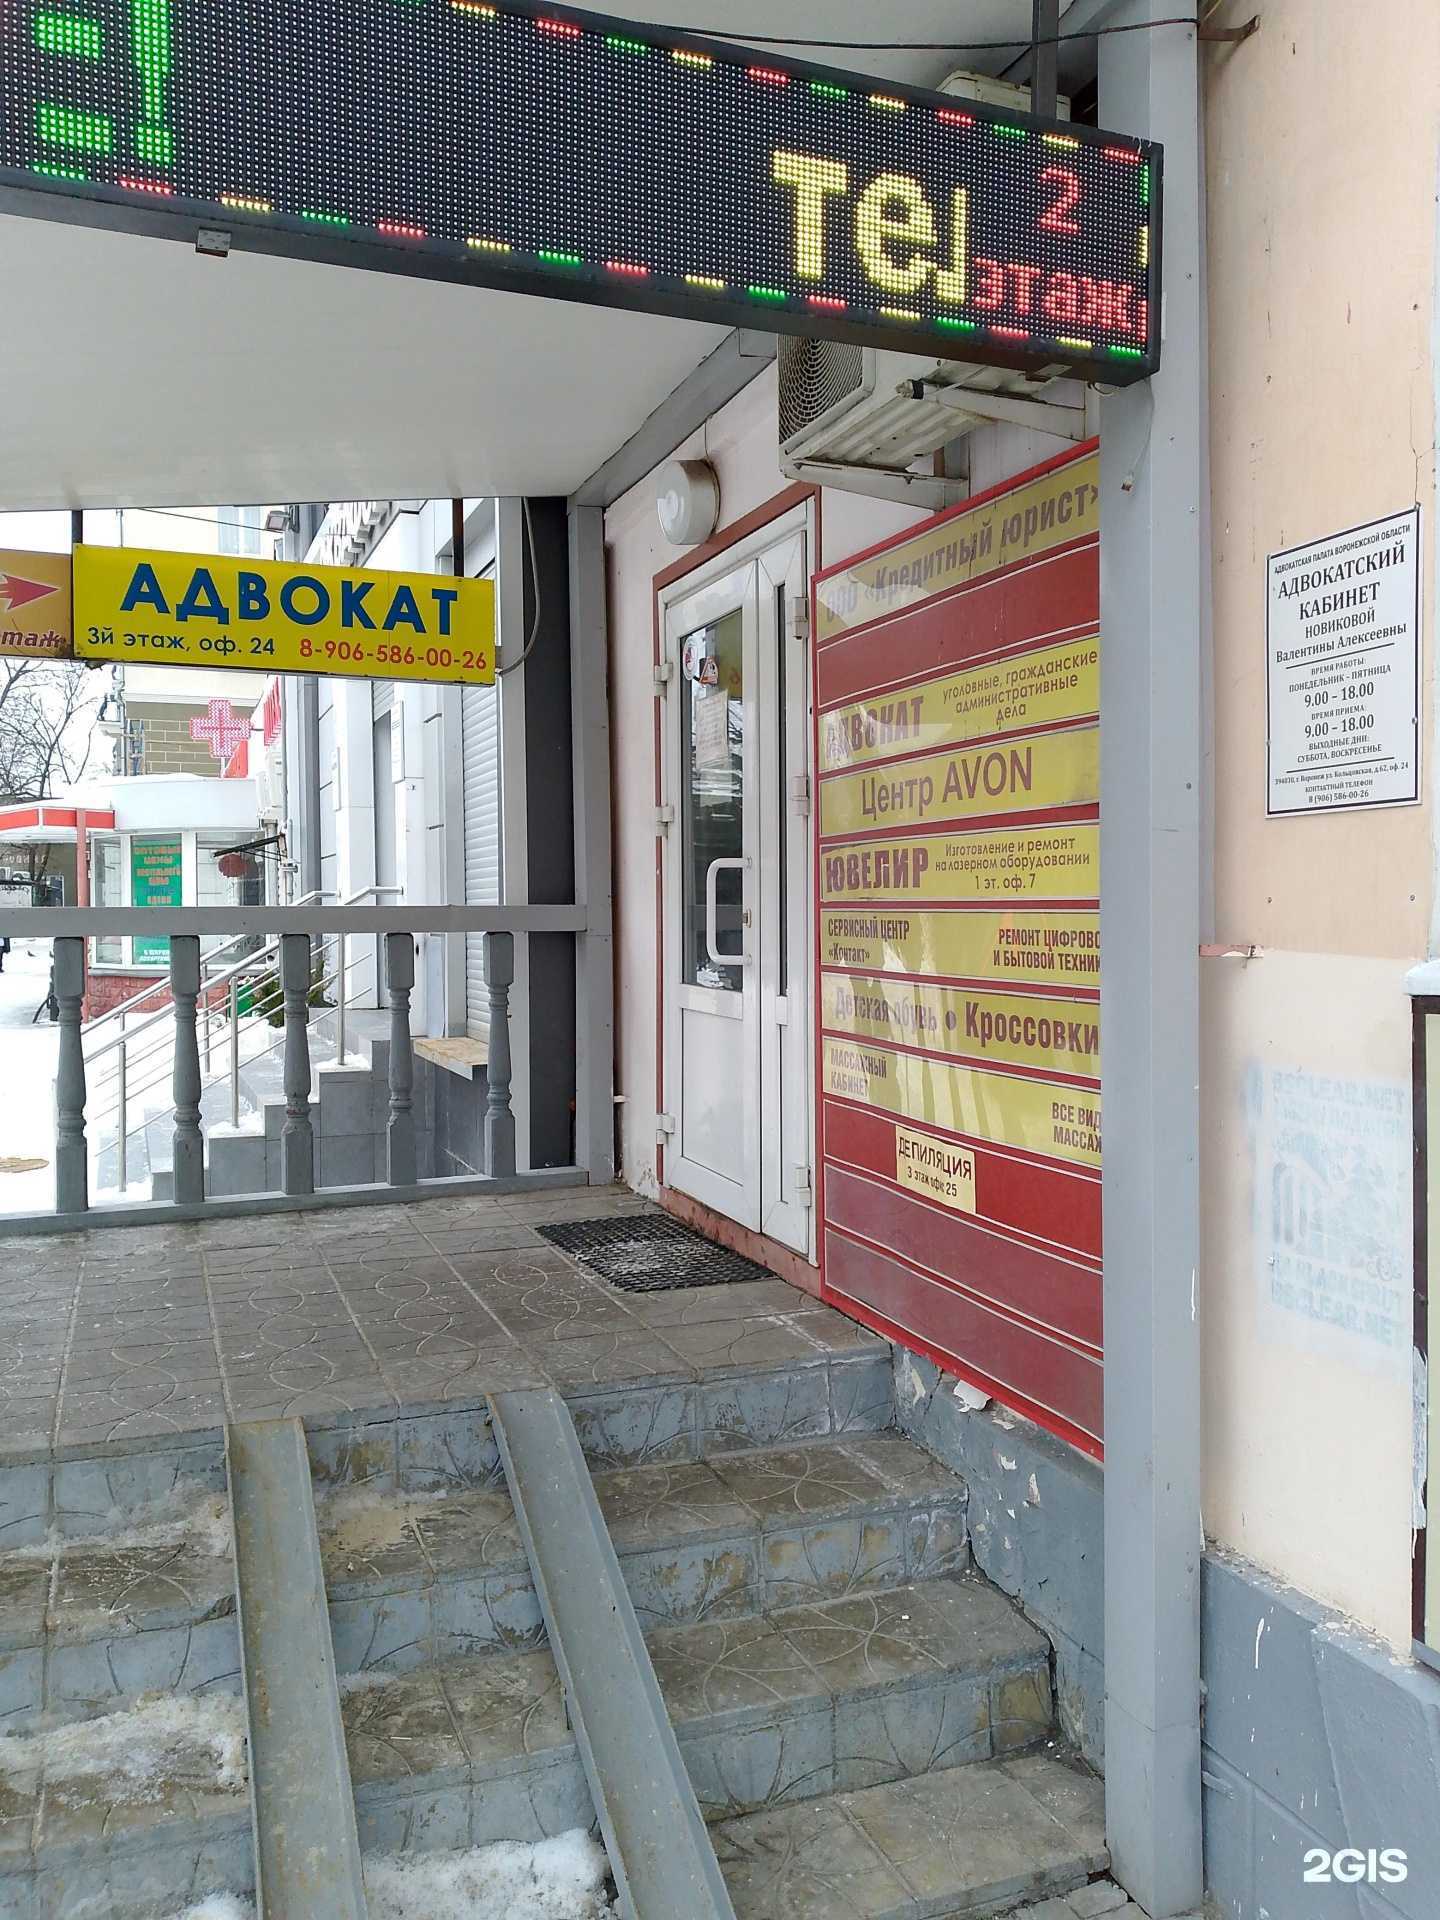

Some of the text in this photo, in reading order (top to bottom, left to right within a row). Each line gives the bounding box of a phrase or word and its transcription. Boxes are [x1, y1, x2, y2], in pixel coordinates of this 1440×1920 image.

[1037, 164, 1080, 234] 2
[974, 257, 1133, 328] этаж
[1274, 524, 1411, 574] АДВОКАТСКАЯ ПАЛАТА ВОРОНЕЖСКОЙ ОБЛАСТИ
[1278, 540, 1406, 599] АДВОКАТСКИЙ
[120, 563, 457, 636] АДВОКАТ
[1299, 581, 1381, 620] КАБИНЕТ
[1305, 606, 1375, 639] НОВИКОВОЙ
[87, 626, 275, 656] 3й этаж, оф. 24
[300, 638, 487, 670] 8-906-586-00-26
[1276, 623, 1407, 663] Валентины Алексеевны
[1006, 650, 1098, 687] гражданские
[1289, 674, 1345, 693] ПОНЕДЕЛЬНИК
[1351, 664, 1391, 681] ПЯТНИЦА
[1311, 663, 1334, 676] ВРЕМЯ
[956, 674, 1079, 714] административные
[1304, 691, 1329, 708] 9.00
[1341, 681, 1374, 701] 18.00
[996, 703, 1026, 725] дела
[1304, 722, 1329, 738] 9.00
[1341, 714, 1374, 733] 18.00
[1311, 710, 1334, 721] ВРЕМЯ
[1308, 737, 1350, 751] ВЫХОДНЫЕ
[1330, 743, 1382, 759] ВОСКРЕСЕНЬЕ
[862, 747, 1032, 821] Центр AVON
[935, 853, 1090, 872] на лазерном оборудовании
[945, 838, 1076, 857] Изготовление и ремонт
[825, 848, 929, 893] ЮВЕЛИР
[975, 873, 1036, 892] 1 эт. оф. 7
[828, 916, 910, 942] СЕРВИСНЫЙ ЦЕНТР
[998, 928, 1041, 947] РЕМОНТ
[828, 943, 870, 963] «Контакт»
[993, 950, 1000, 966] И
[1003, 951, 1055, 970] БЫТОВОЙ
[965, 1001, 1099, 1056] Кроссовки
[1052, 1102, 1074, 1123] ВСЕ
[899, 1136, 972, 1181] ДЕПИЛЯЦИЯ
[907, 1166, 913, 1178] 3
[946, 1182, 957, 1197] 25
